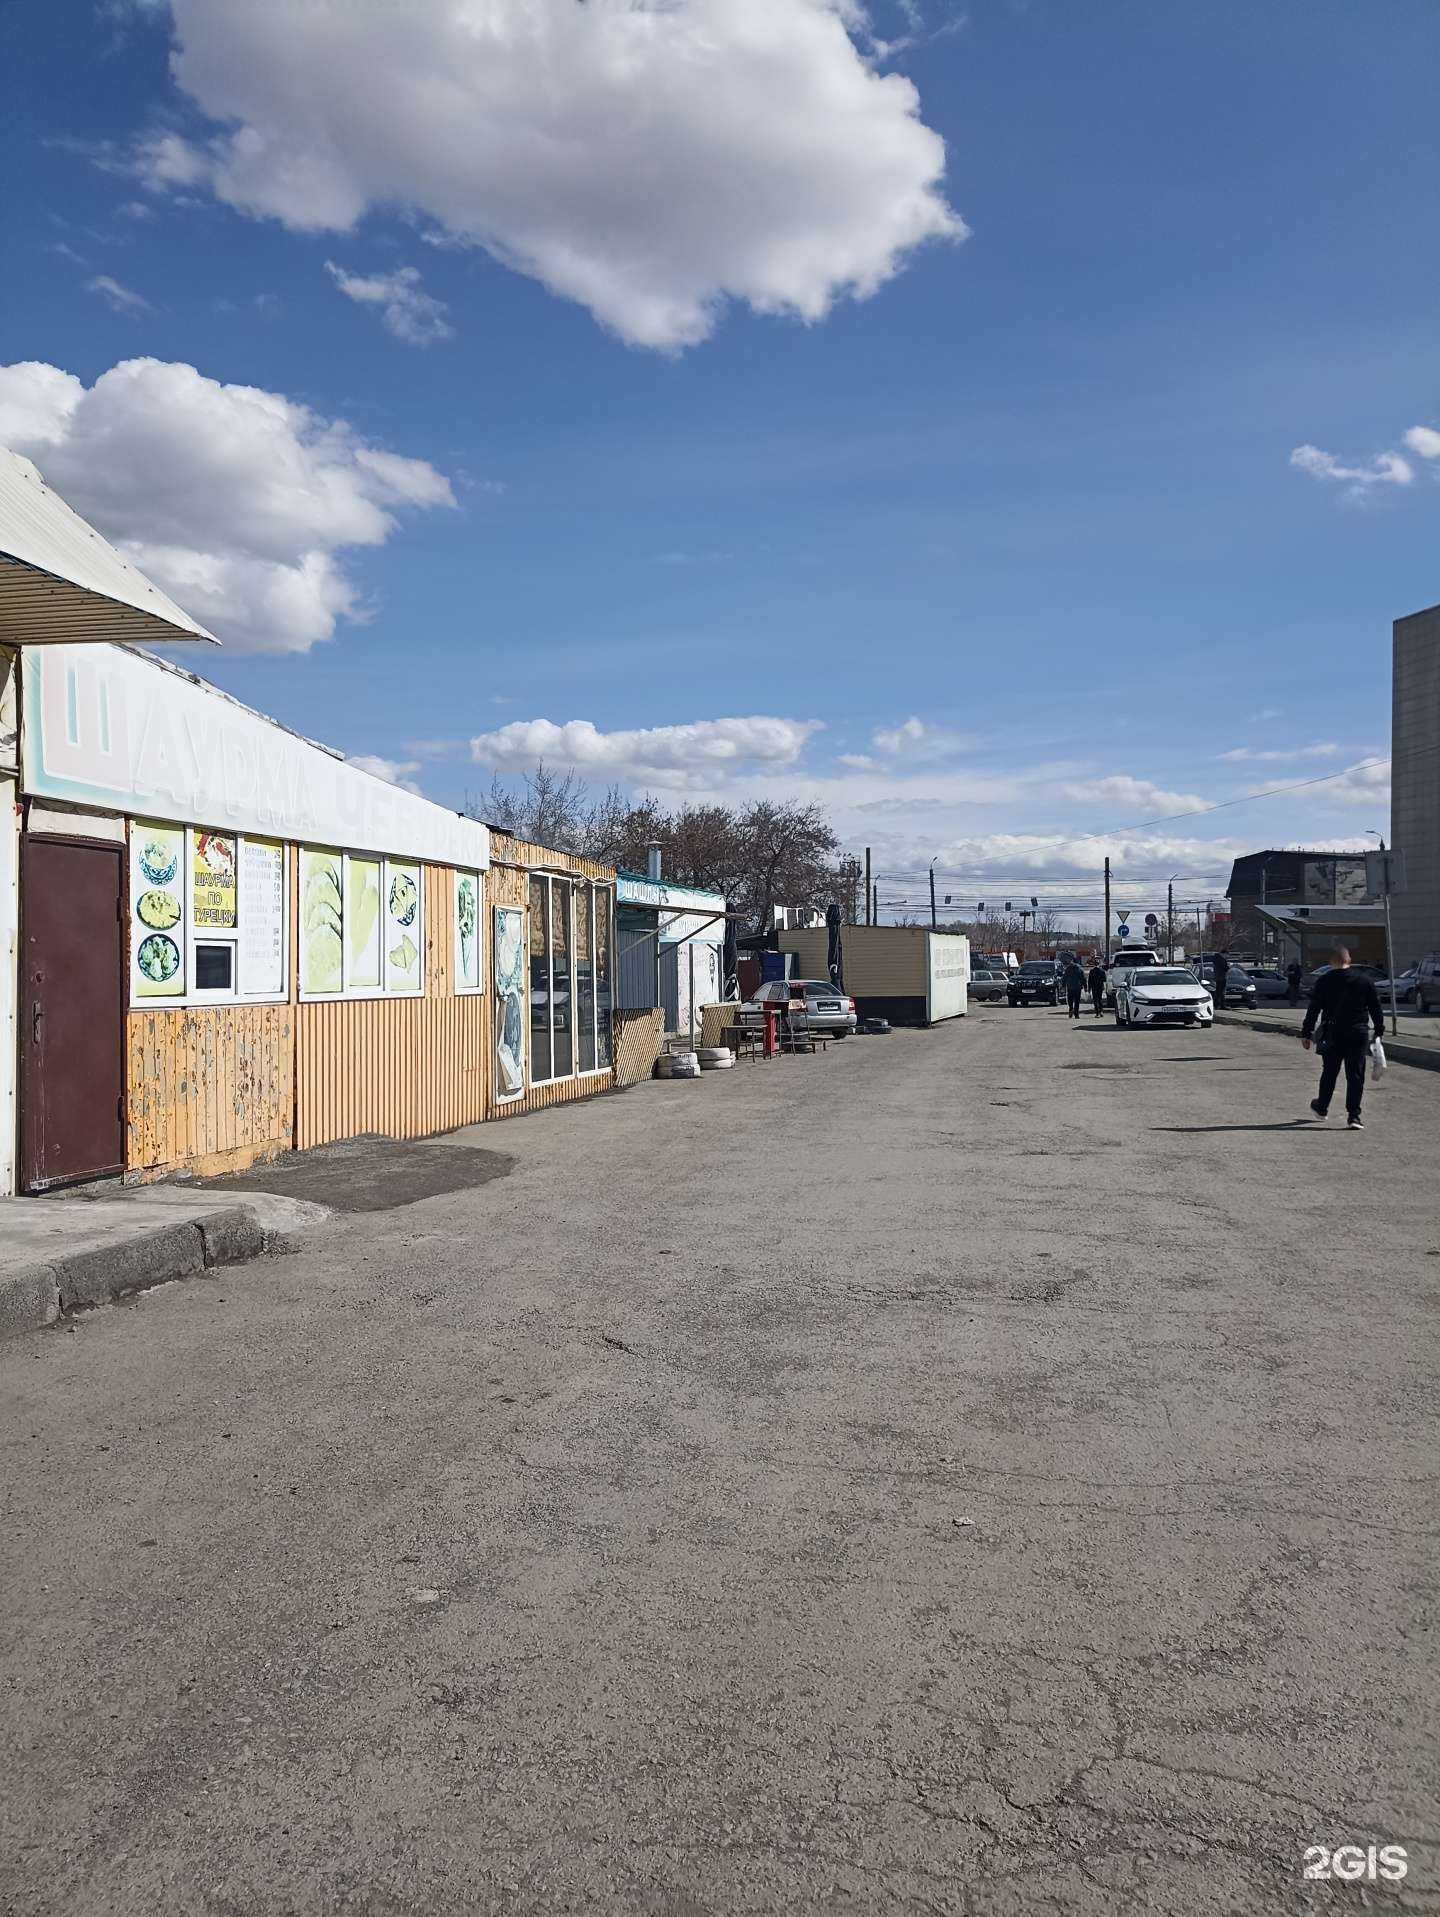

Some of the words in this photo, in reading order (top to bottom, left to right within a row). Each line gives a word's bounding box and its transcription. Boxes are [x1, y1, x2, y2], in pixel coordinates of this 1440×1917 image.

[42, 645, 319, 831] ШАУРМА
[194, 871, 235, 888] ШАУРМА
[207, 891, 223, 905] ПО
[193, 907, 235, 924] ТУРЕЦКИ
